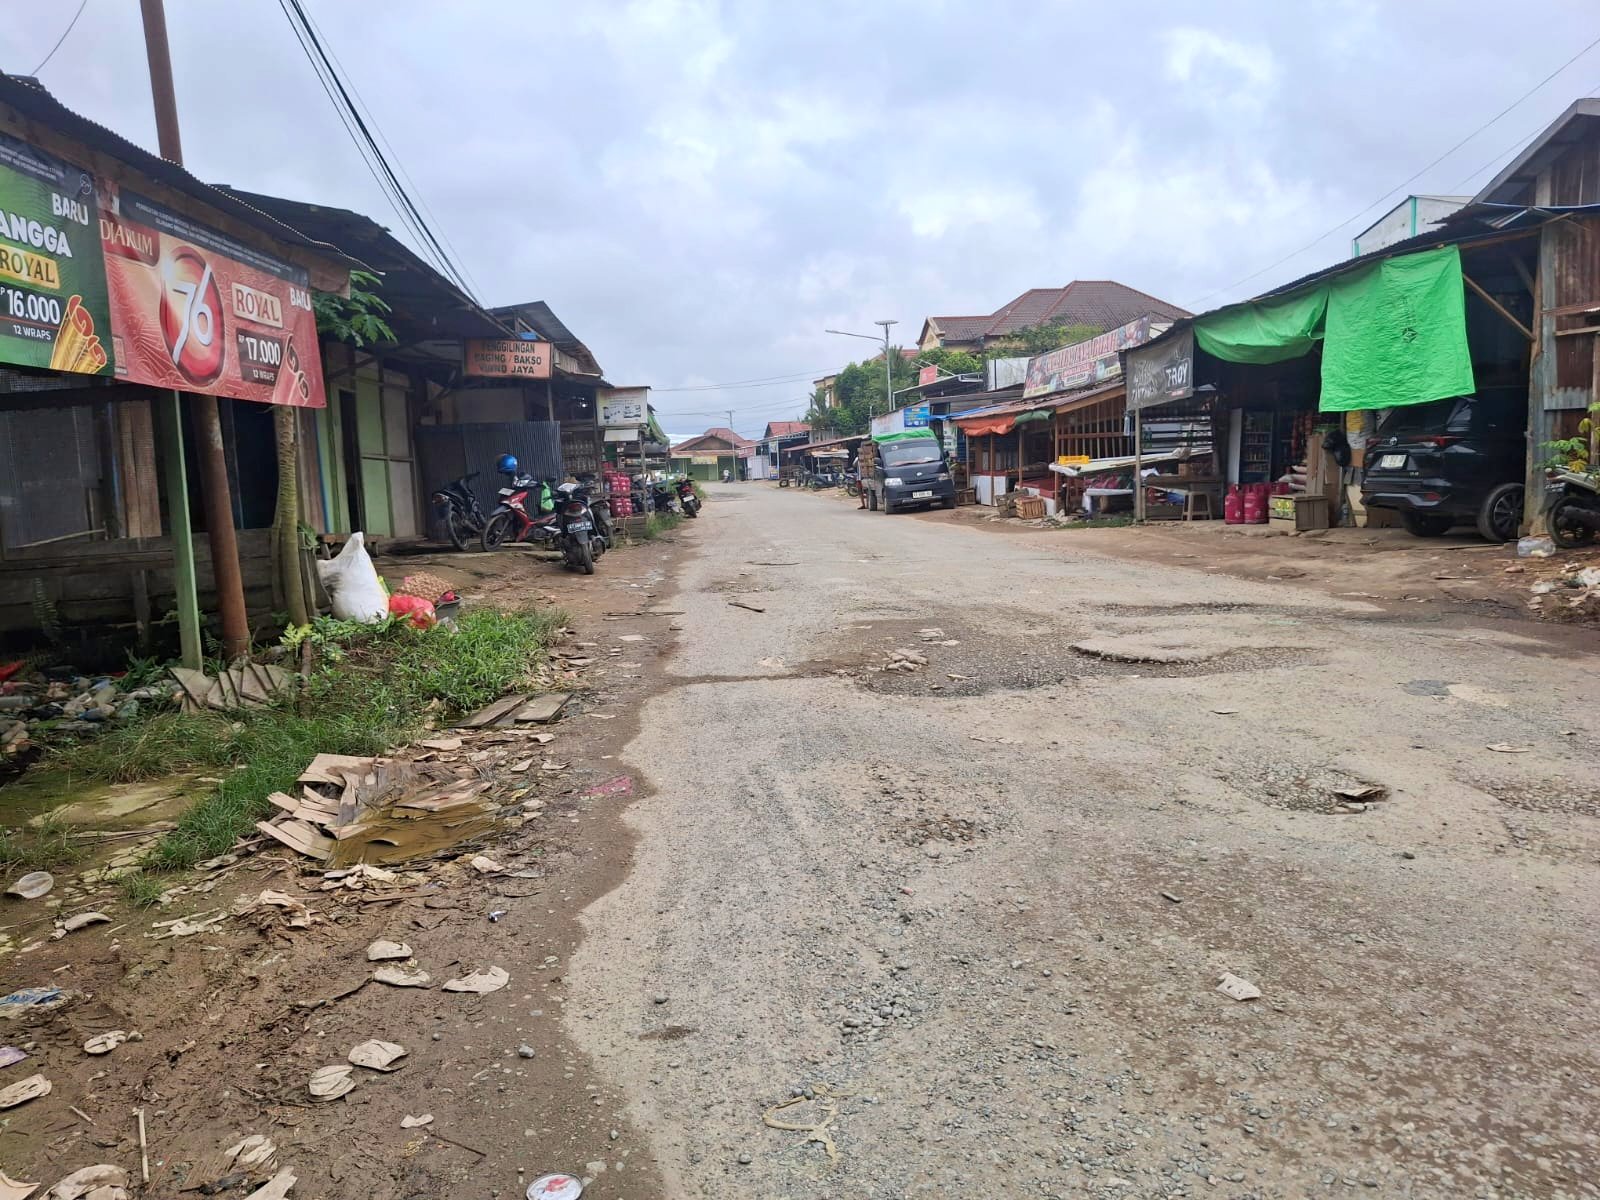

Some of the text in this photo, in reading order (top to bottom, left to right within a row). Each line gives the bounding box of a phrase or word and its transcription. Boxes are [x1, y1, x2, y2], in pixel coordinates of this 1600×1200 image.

[52, 193, 89, 226] BARU
[0, 249, 56, 283] ROYAL
[6, 288, 61, 326] 16.000
[235, 287, 280, 321] ROYAL
[290, 287, 312, 312] BARU
[172, 263, 214, 366] 76
[13, 324, 52, 341] 12 WRAPS
[245, 337, 281, 366] 17.000
[482, 341, 536, 354] EGGILINGAN
[514, 355, 542, 365] BAKSO
[252, 368, 260, 379] 12
[511, 365, 535, 374] JAYA
[1165, 361, 1189, 387] TROY
